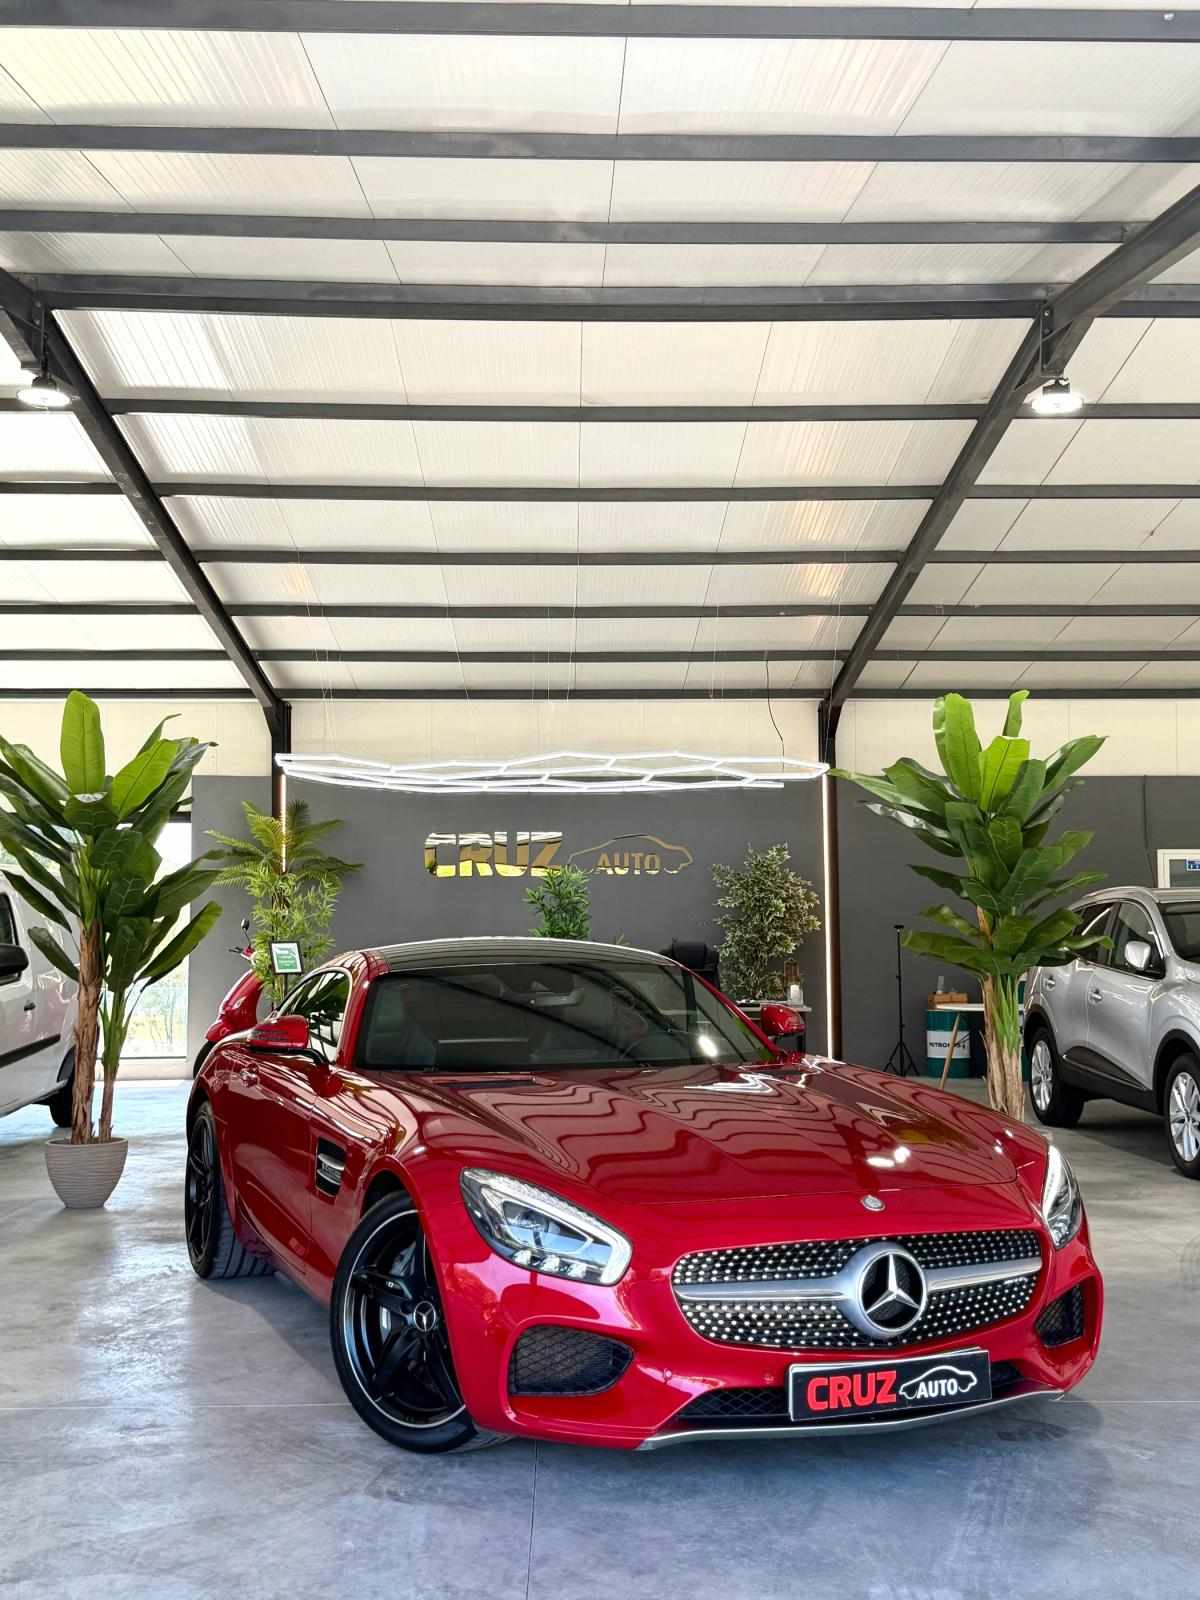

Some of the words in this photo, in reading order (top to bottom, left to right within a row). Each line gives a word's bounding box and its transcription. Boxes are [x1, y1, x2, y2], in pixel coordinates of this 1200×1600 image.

[424, 831, 563, 878] CRUZ
[597, 852, 661, 876] AUTO
[807, 1370, 897, 1412] CRUZ
[916, 1378, 958, 1399] AUTO
